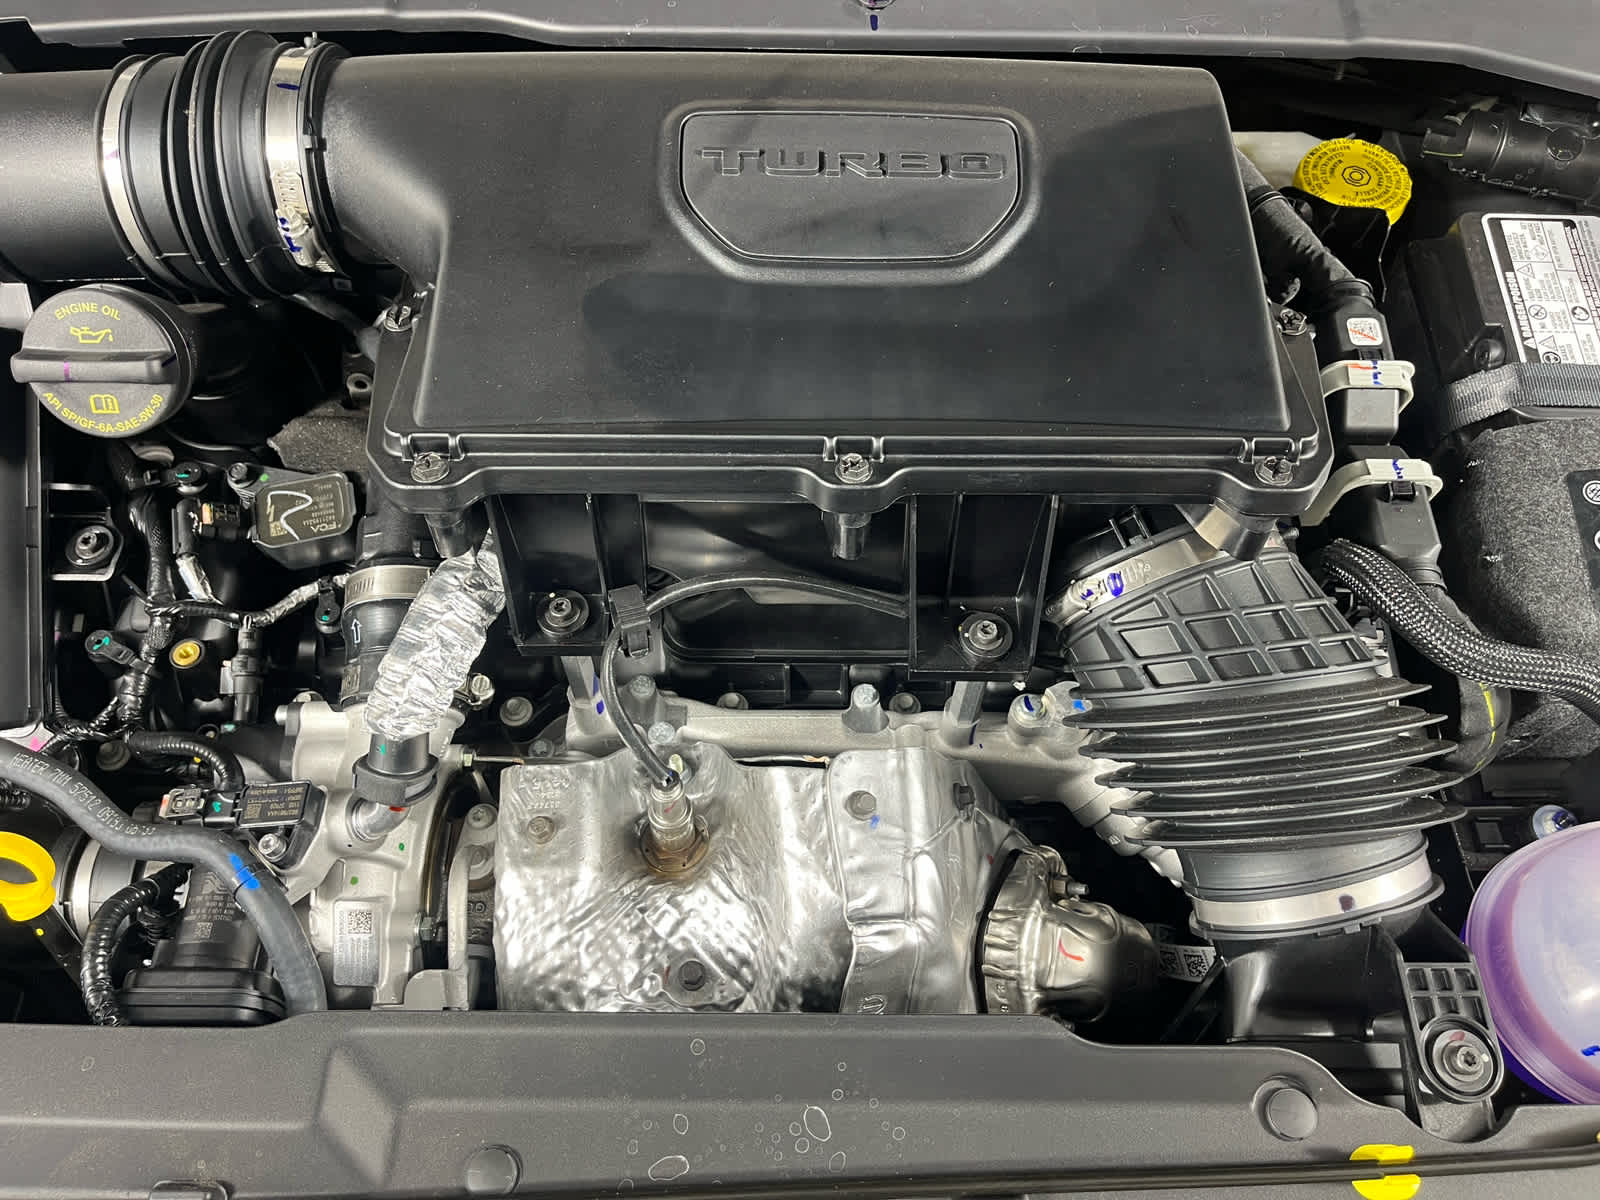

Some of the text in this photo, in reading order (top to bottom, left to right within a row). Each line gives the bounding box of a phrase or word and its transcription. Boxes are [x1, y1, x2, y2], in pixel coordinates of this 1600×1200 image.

[699, 149, 1007, 180] TURBO
[55, 302, 122, 321] ENGINE OIL
[42, 391, 64, 412] API
[8, 752, 50, 775] HEATER
